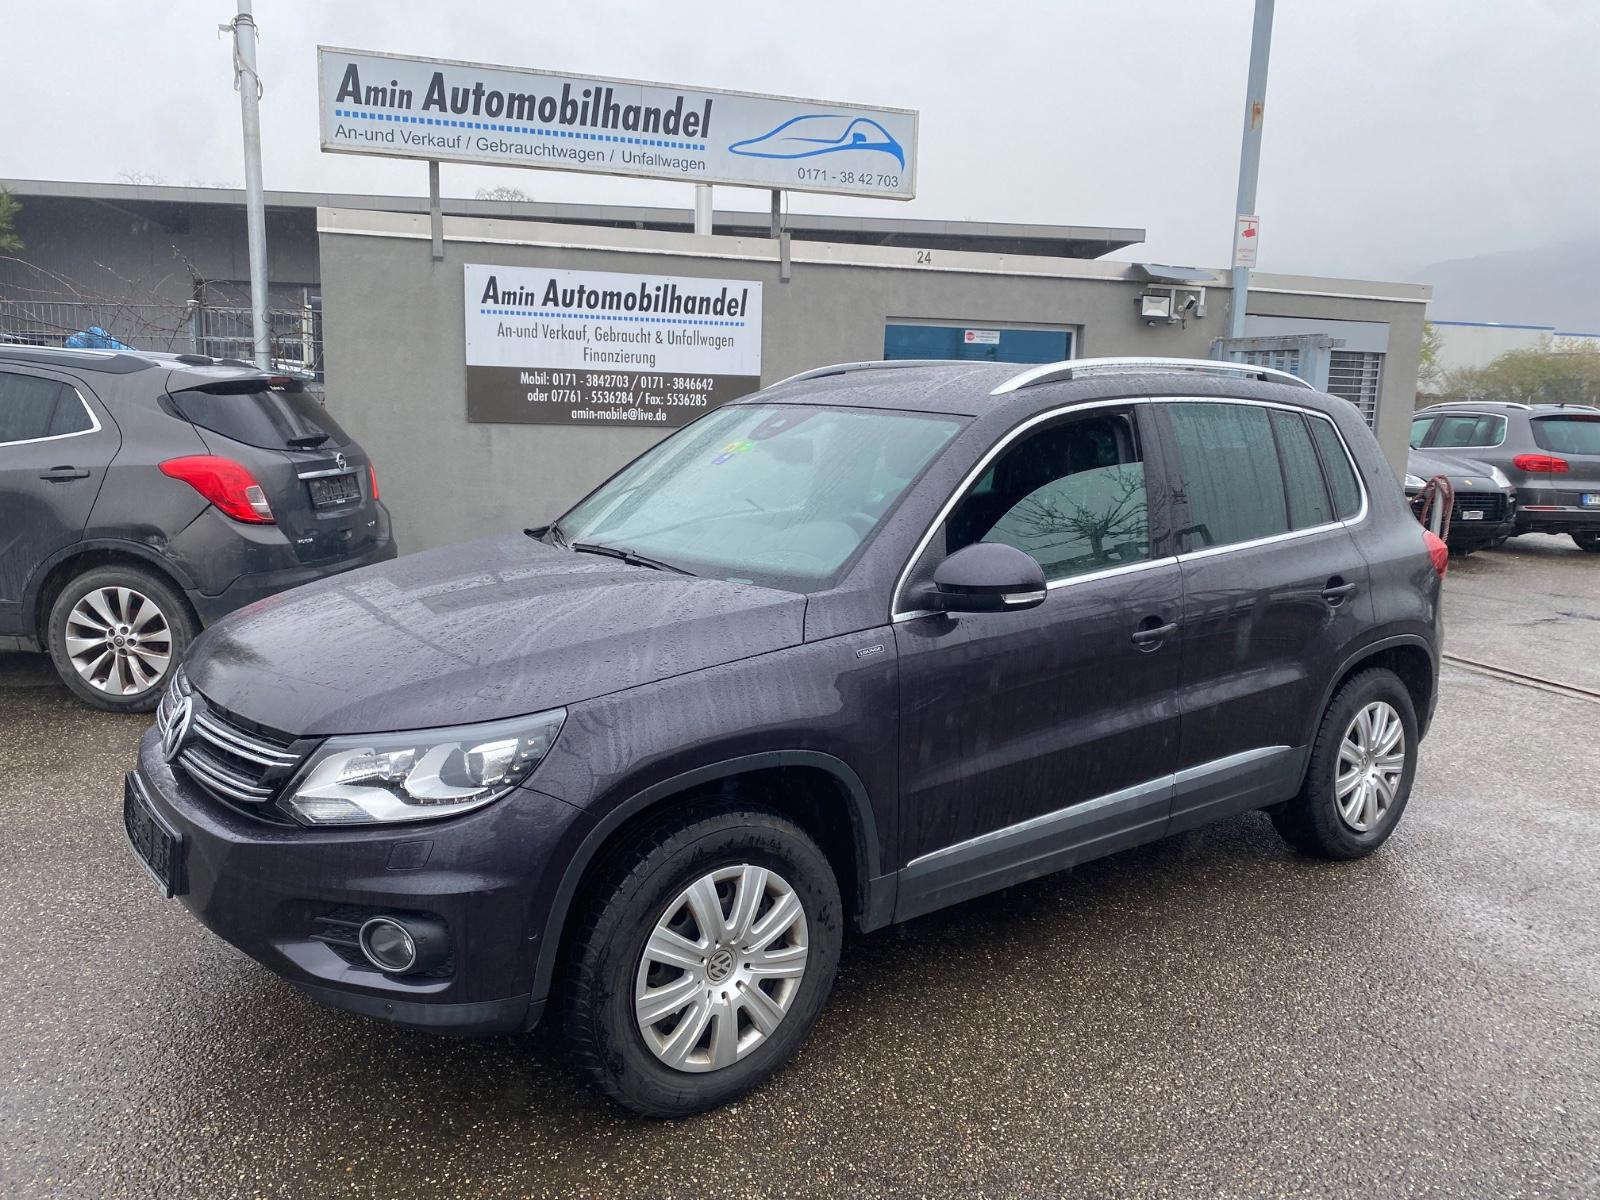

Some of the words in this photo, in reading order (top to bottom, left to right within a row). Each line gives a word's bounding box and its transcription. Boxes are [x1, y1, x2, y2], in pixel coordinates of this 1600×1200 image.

[335, 63, 413, 110] Amin
[421, 71, 712, 138] Automobilhandel
[335, 124, 395, 143] An-und
[400, 130, 461, 149] Verkauf
[466, 136, 471, 150] /
[476, 137, 605, 163] Gebrauchtwagen
[622, 150, 706, 172] Unfallwagen
[797, 167, 827, 181] 0171
[840, 171, 855, 184] 38
[858, 173, 873, 185] 42
[877, 174, 899, 188] 703
[917, 251, 932, 264] 24
[481, 275, 535, 307] Amin
[542, 278, 749, 317] Automobilhandel
[497, 321, 538, 339] An-und
[542, 324, 590, 344] Verkauf,
[594, 326, 652, 344] Gebraucht
[655, 330, 664, 343] &
[667, 329, 735, 351] Unfallwagen
[583, 347, 656, 368] Finanzierung
[520, 371, 549, 385] Mobil:
[553, 373, 576, 386] 0171
[586, 374, 629, 388] 3842703
[631, 375, 639, 391] /
[641, 376, 664, 389] 0171
[673, 377, 714, 391] 3846642
[527, 388, 549, 402] oder
[551, 389, 581, 403] 07761
[591, 391, 633, 404] 5536284
[635, 391, 643, 407] /
[645, 392, 664, 405] Fax:
[667, 393, 707, 406] 5536285
[571, 406, 667, 421] amin-mobile@live.de
